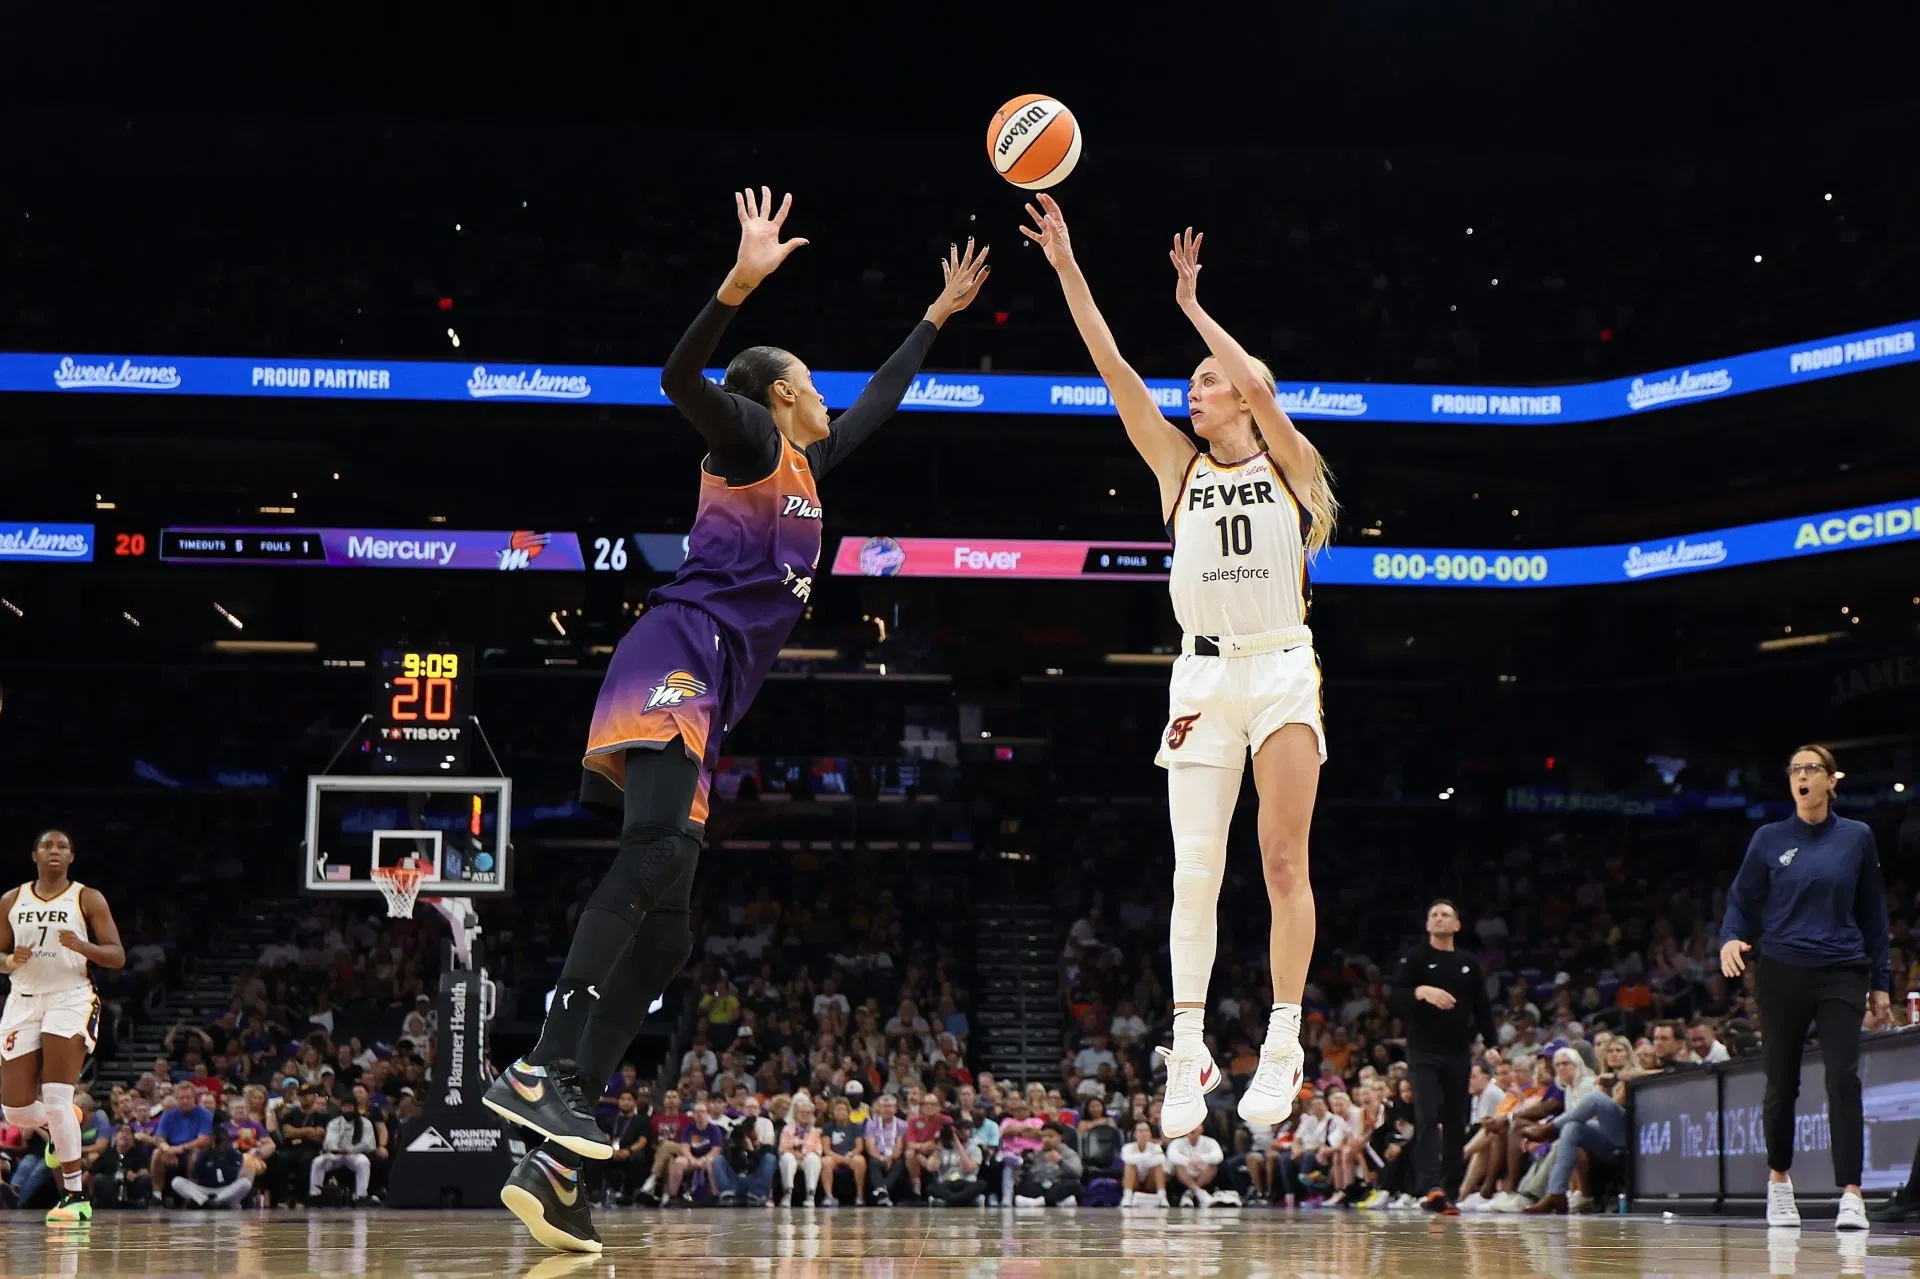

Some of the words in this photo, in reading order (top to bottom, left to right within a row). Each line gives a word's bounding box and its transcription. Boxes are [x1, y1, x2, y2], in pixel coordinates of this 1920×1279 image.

[998, 105, 1048, 155] Wilson
[1790, 344, 1843, 374] PROUD
[1844, 331, 1915, 363] PARTNER
[53, 356, 115, 382] Sweet
[113, 359, 177, 383] James
[252, 367, 311, 388] PROUD
[313, 368, 390, 390] PARTNER
[467, 366, 526, 391] Sweet
[524, 369, 588, 393] James
[1051, 385, 1107, 406] PROUD
[1303, 386, 1364, 410] James
[1432, 394, 1488, 415] PROUD
[1488, 395, 1562, 416] PARTNER
[1188, 481, 1276, 511] FEVER
[115, 533, 145, 556] 20
[178, 539, 226, 551] TIMEOUTS
[235, 539, 243, 553] 5
[260, 541, 291, 552] FOULS
[303, 540, 309, 554] 1
[1215, 514, 1252, 557] 10
[348, 535, 456, 566] Mercury
[594, 537, 628, 571] 26
[954, 547, 1022, 570] Fever
[1100, 554, 1110, 568] 0
[1116, 555, 1148, 567] FOULS
[1202, 565, 1270, 583] salesforce
[1373, 553, 1548, 582] 800-900-000
[404, 653, 458, 679] 9:09
[391, 677, 453, 721] 20
[402, 727, 460, 741] TISSOT
[472, 872, 496, 883] AT&T
[18, 910, 68, 925] FEVER
[38, 926, 48, 947] 7
[450, 981, 467, 1031] Health
[448, 1032, 465, 1088] Banner
[450, 1129, 501, 1140] MOUNTAIN
[1679, 1113, 1704, 1158] The
[1748, 1103, 1768, 1154] Ki
[452, 1138, 498, 1149] AMERICA
